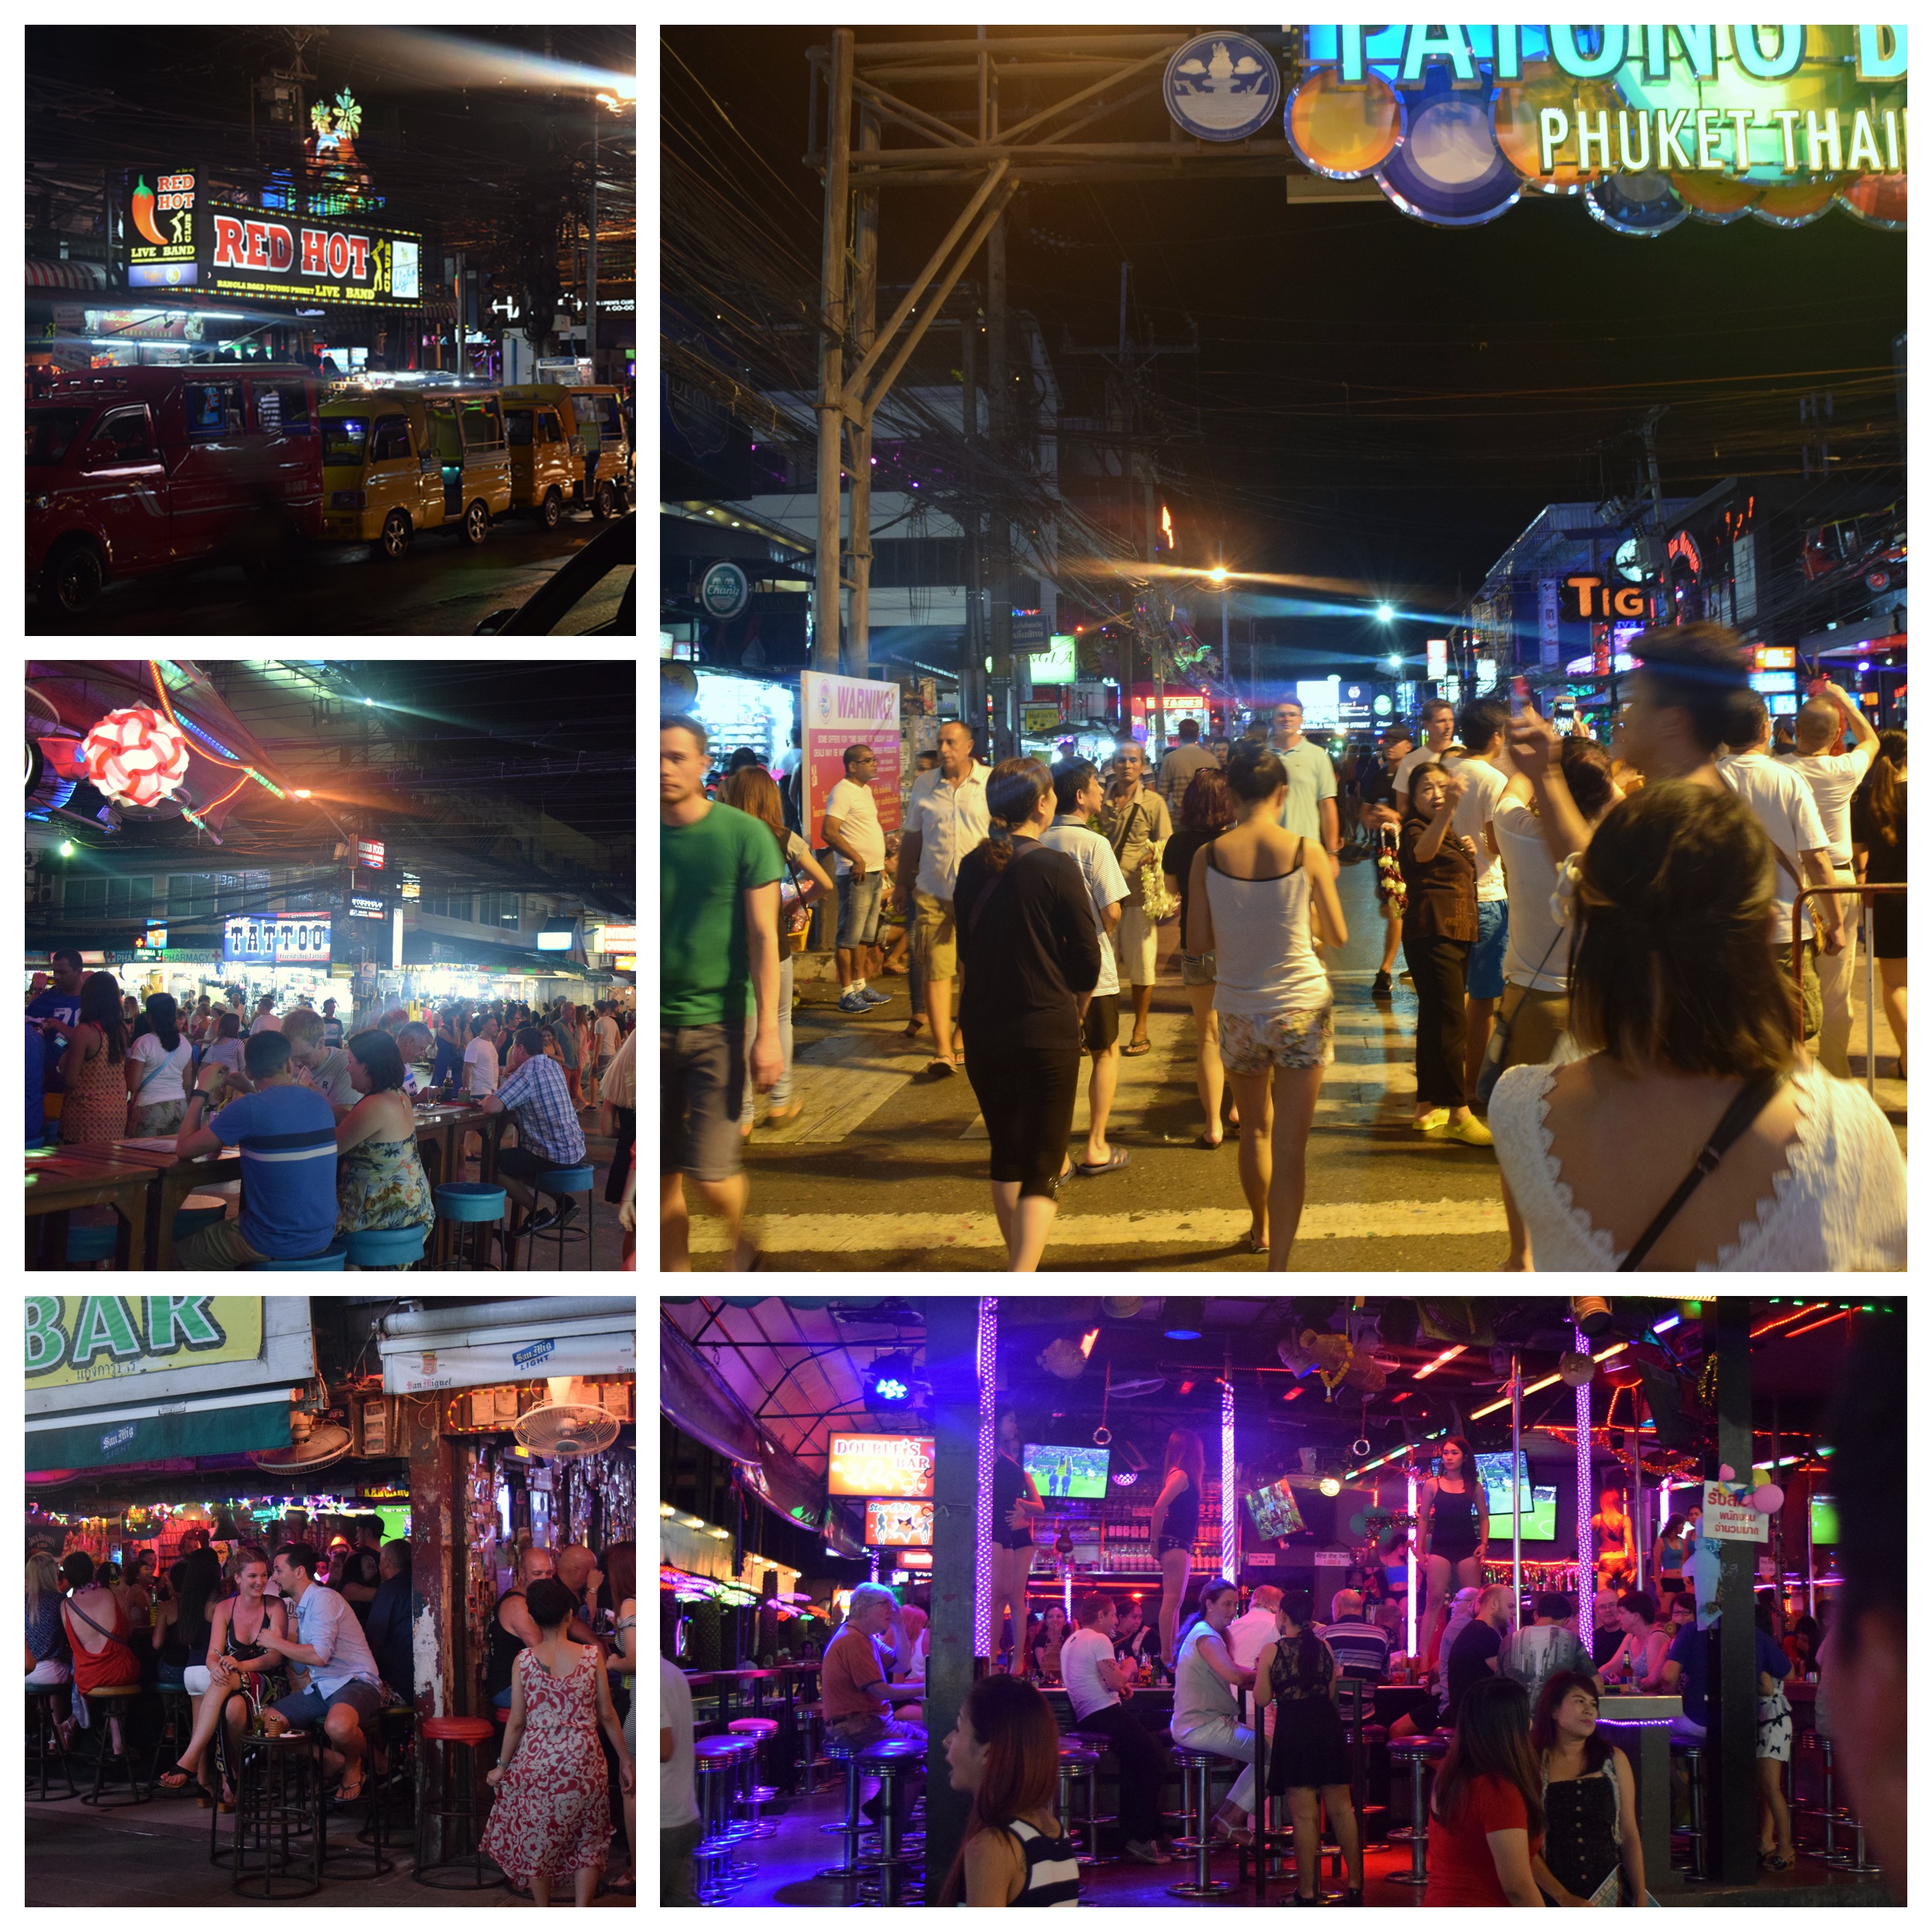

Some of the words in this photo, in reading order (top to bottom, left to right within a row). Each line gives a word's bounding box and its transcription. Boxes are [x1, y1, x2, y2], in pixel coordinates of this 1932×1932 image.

[1538, 107, 1756, 172] PHUKET
[1776, 107, 1907, 172] THAI
[158, 174, 195, 192] RED
[158, 192, 195, 210] HOT
[131, 247, 156, 257] LIVE
[163, 245, 195, 256] BAND
[213, 215, 294, 272] RED
[301, 229, 369, 279] HOT
[143, 270, 163, 283] Tiger
[394, 268, 417, 291] Light
[216, 280, 246, 290] BANGLA
[247, 282, 265, 291] ROAD
[266, 284, 291, 293] PATONG
[291, 286, 315, 295] PHUKET
[315, 285, 340, 298] LIVE
[345, 287, 375, 300] BAND
[706, 584, 740, 597] Chang
[358, 841, 372, 853] INDIAN
[372, 844, 385, 855] FOOD
[231, 924, 322, 951] TATTOO
[164, 952, 210, 962] PHARMACY
[24, 1296, 222, 1372] BAR
[514, 1350, 533, 1363] San
[532, 1342, 553, 1357] Mig
[520, 1354, 551, 1371] LIGHT
[406, 1380, 422, 1390] San
[422, 1377, 452, 1389] Miguel
[103, 1434, 118, 1450] San
[117, 1427, 134, 1444] Mig
[107, 1442, 132, 1459] LIGHT
[835, 1440, 920, 1456] DOUBLE'S
[896, 1457, 929, 1469] BAR
[869, 1503, 888, 1512] Star
[1719, 1510, 1756, 1522] พนักงาน
[1714, 1522, 1759, 1536] จำนวนมาก
